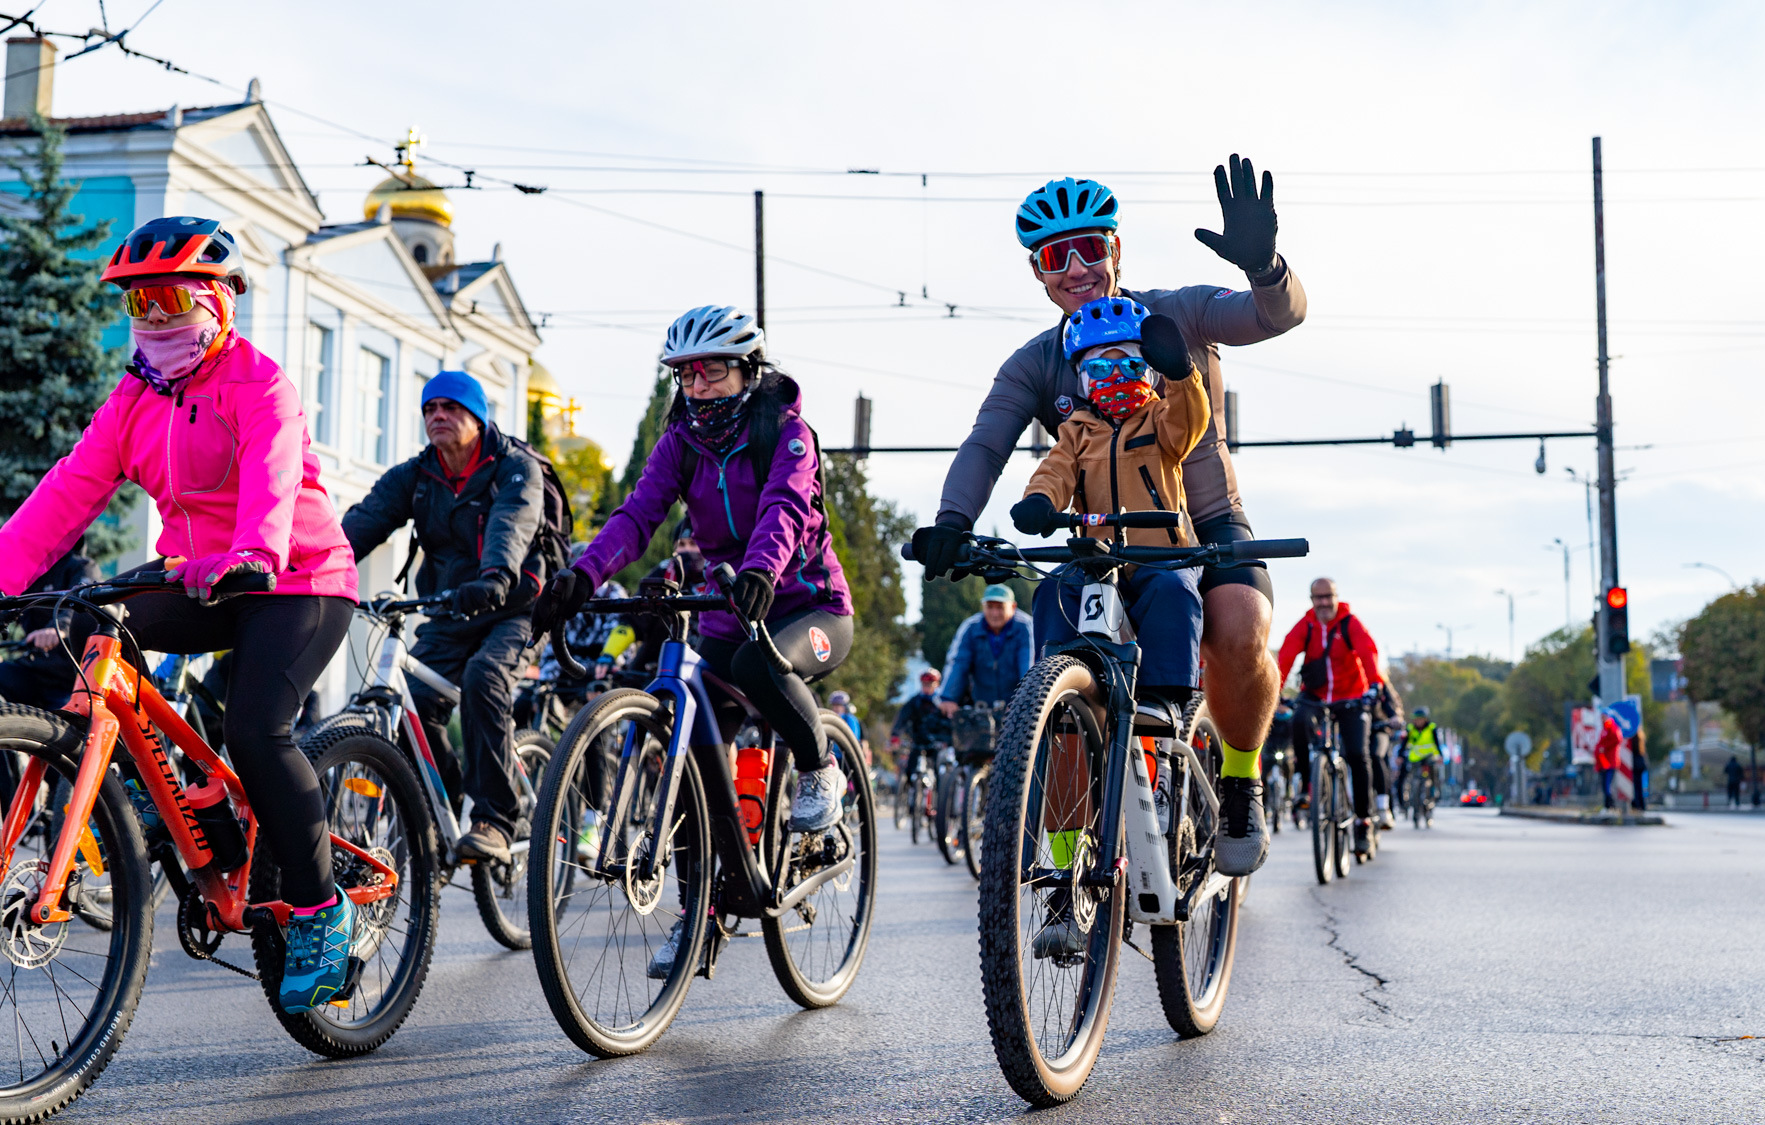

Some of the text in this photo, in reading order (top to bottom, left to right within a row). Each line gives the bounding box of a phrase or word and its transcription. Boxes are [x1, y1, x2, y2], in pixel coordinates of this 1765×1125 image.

[137, 720, 210, 851] SPECIALIZED
[100, 1010, 123, 1048] GROUND
[68, 1048, 101, 1083] CONTROL
